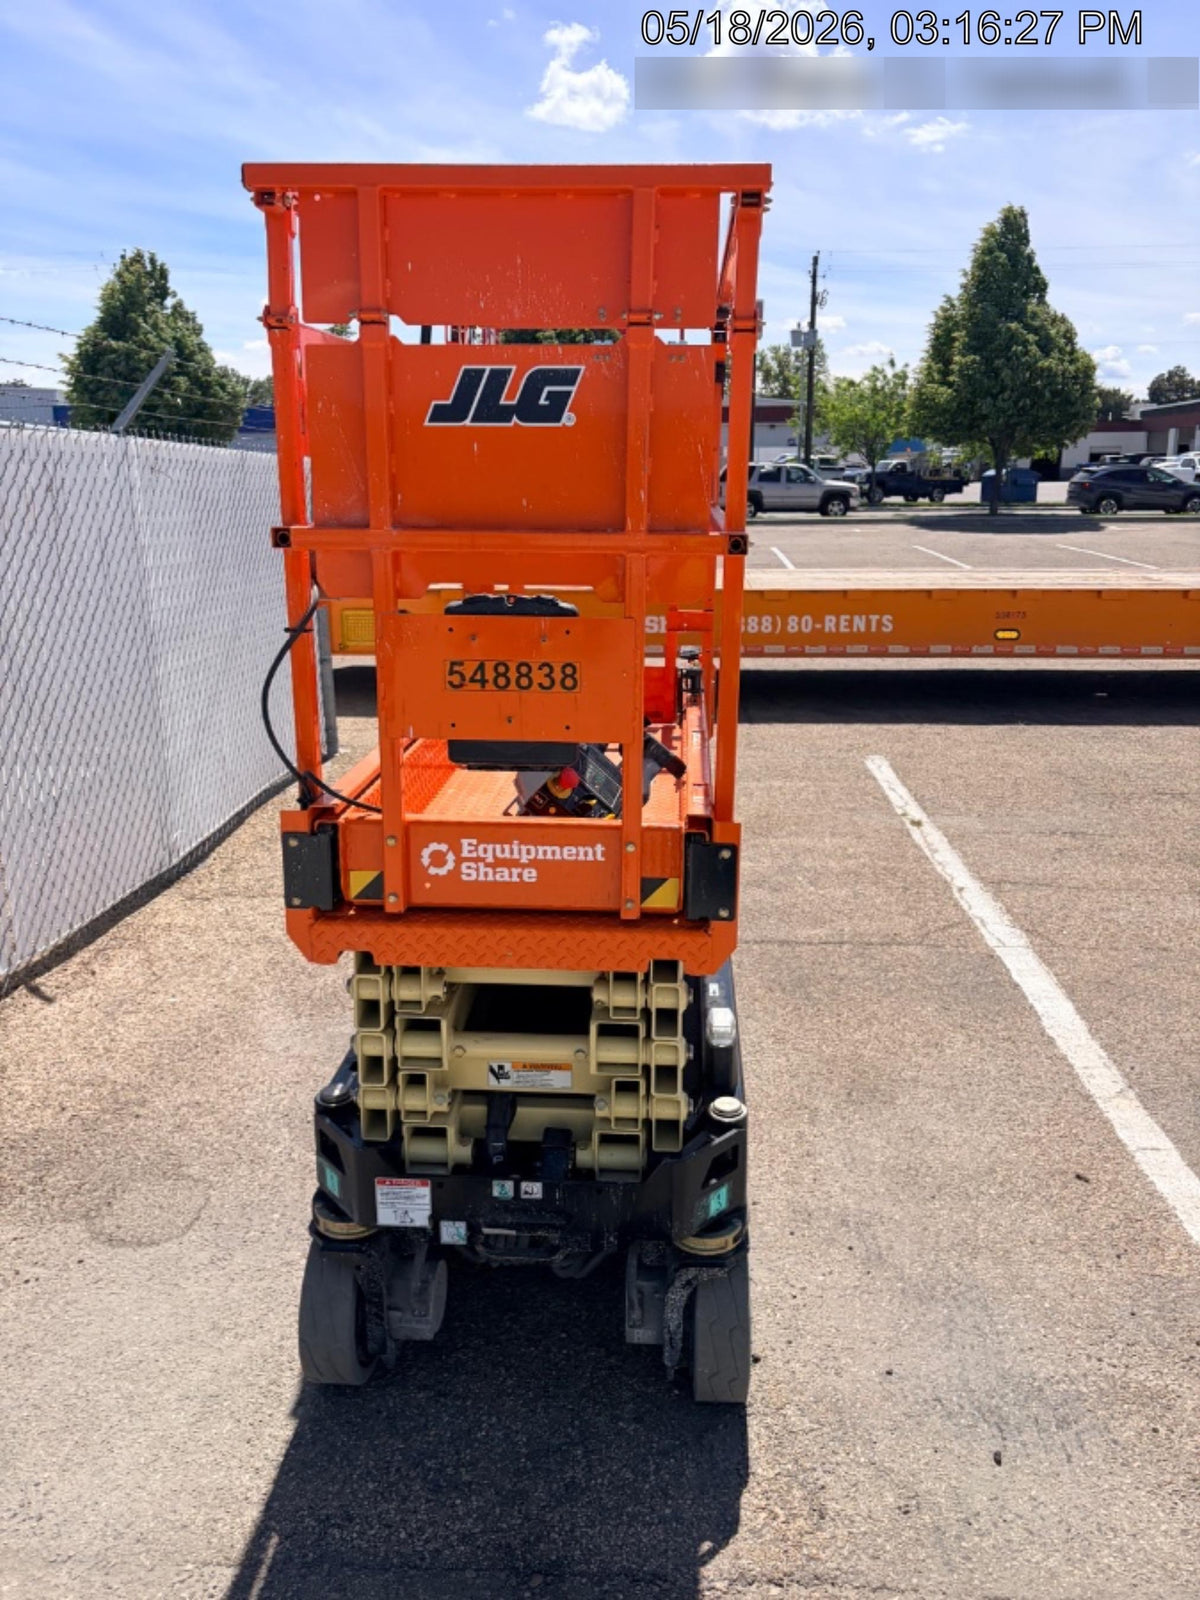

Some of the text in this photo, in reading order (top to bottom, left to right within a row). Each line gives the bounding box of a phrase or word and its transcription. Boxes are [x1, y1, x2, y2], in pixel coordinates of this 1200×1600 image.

[424, 365, 586, 427] JLG
[786, 614, 894, 634] 80-RENTS
[447, 660, 579, 692] 548838
[460, 838, 606, 864] Equipment
[460, 862, 538, 883] Share
